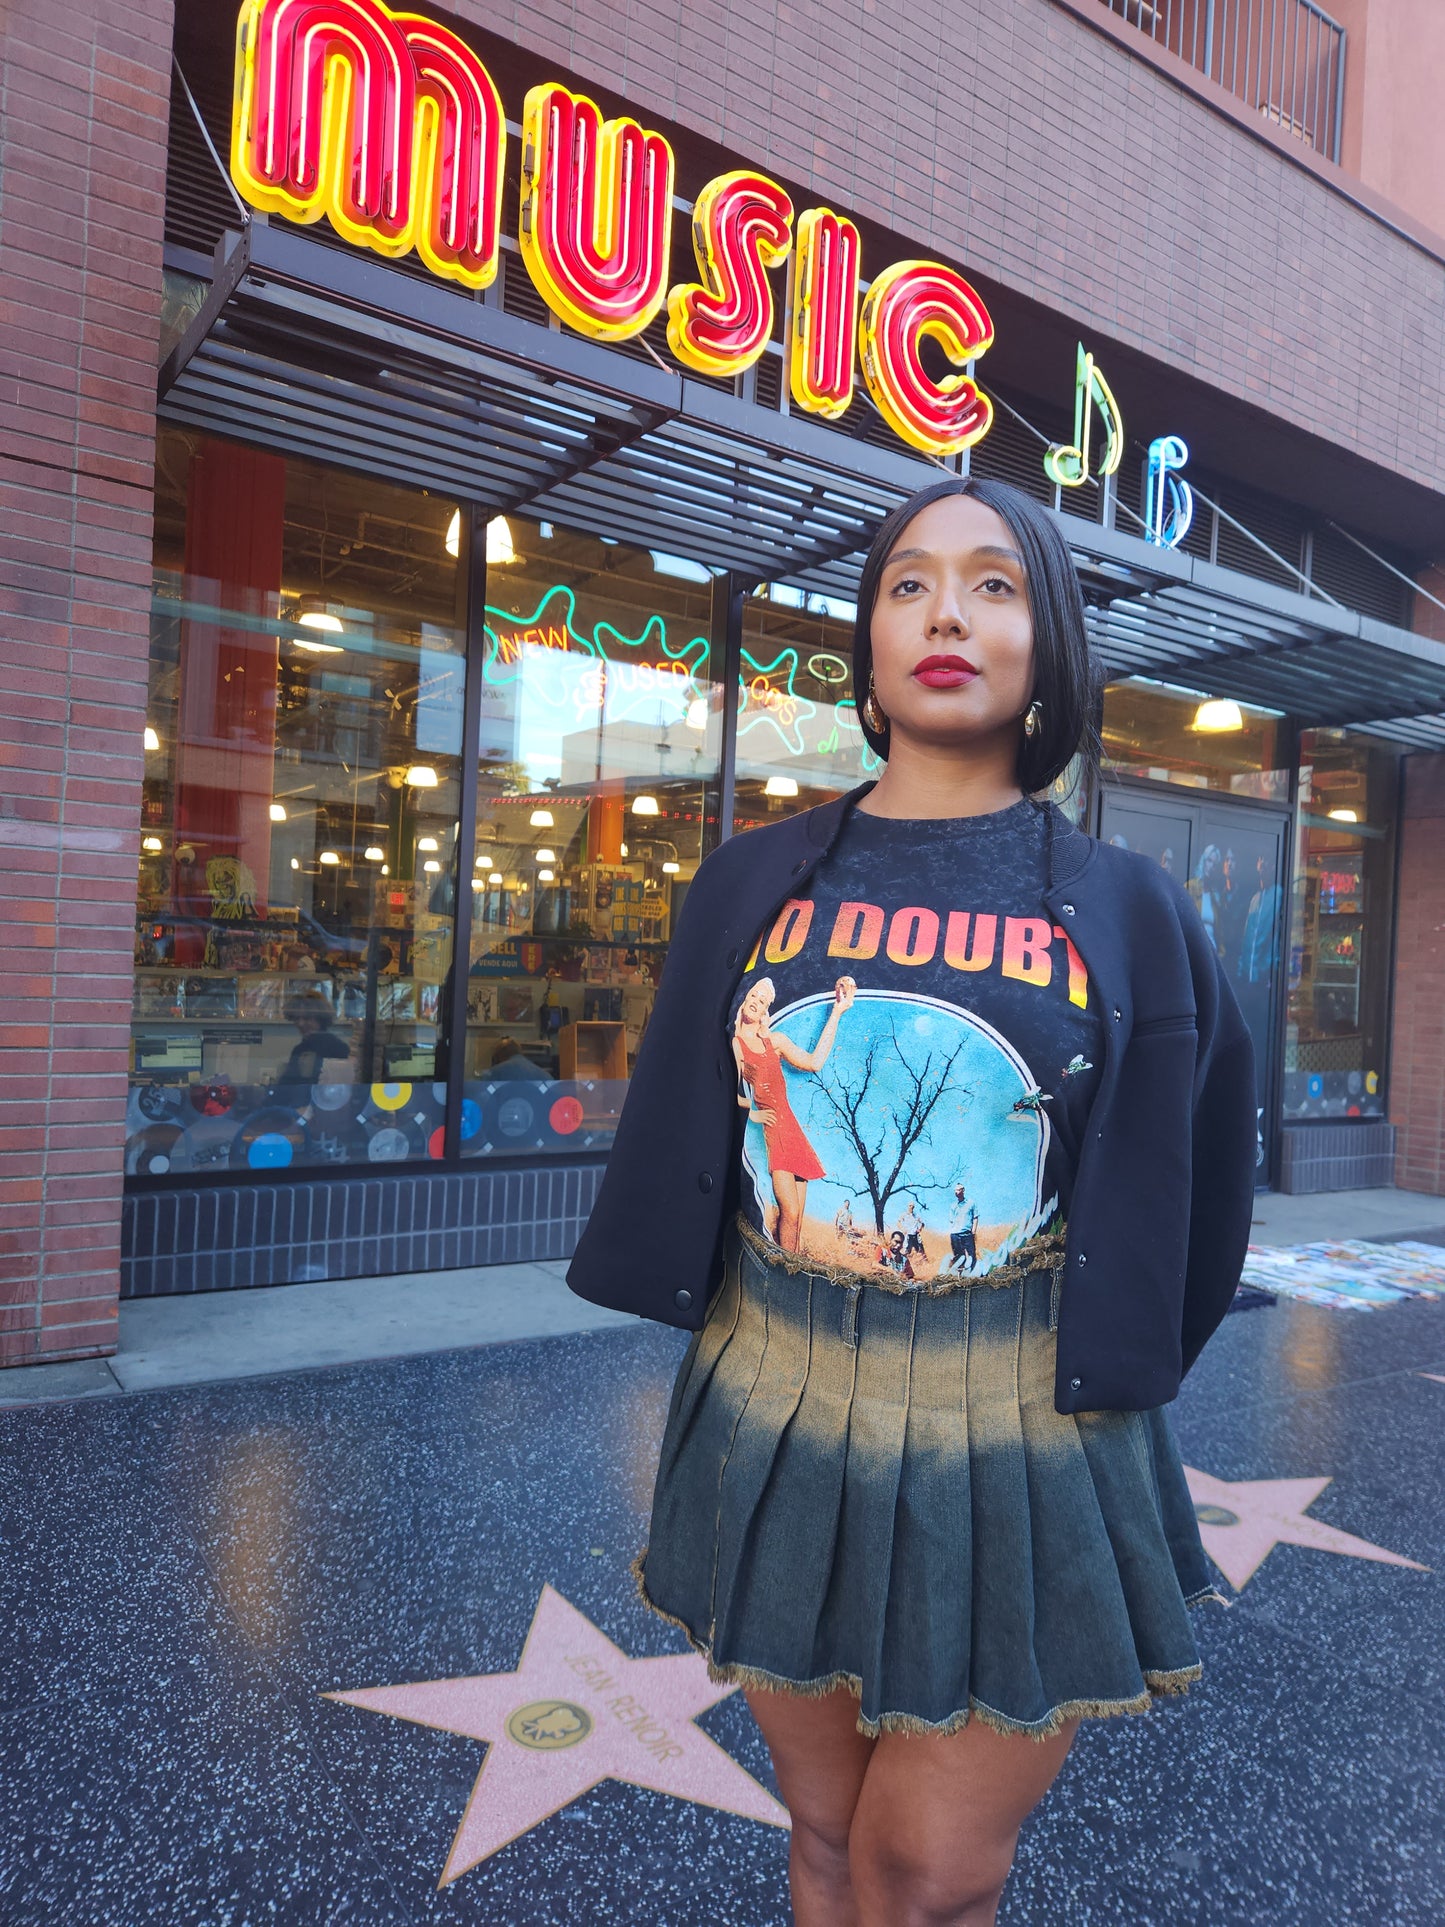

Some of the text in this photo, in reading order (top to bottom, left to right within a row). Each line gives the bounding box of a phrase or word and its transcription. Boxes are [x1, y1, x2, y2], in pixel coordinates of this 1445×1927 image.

[231, 0, 995, 456] MUSIC
[499, 624, 568, 665] NEW
[617, 660, 690, 692] USED
[489, 941, 517, 955] SELL
[563, 1654, 685, 1764] JEAN RENOIR
